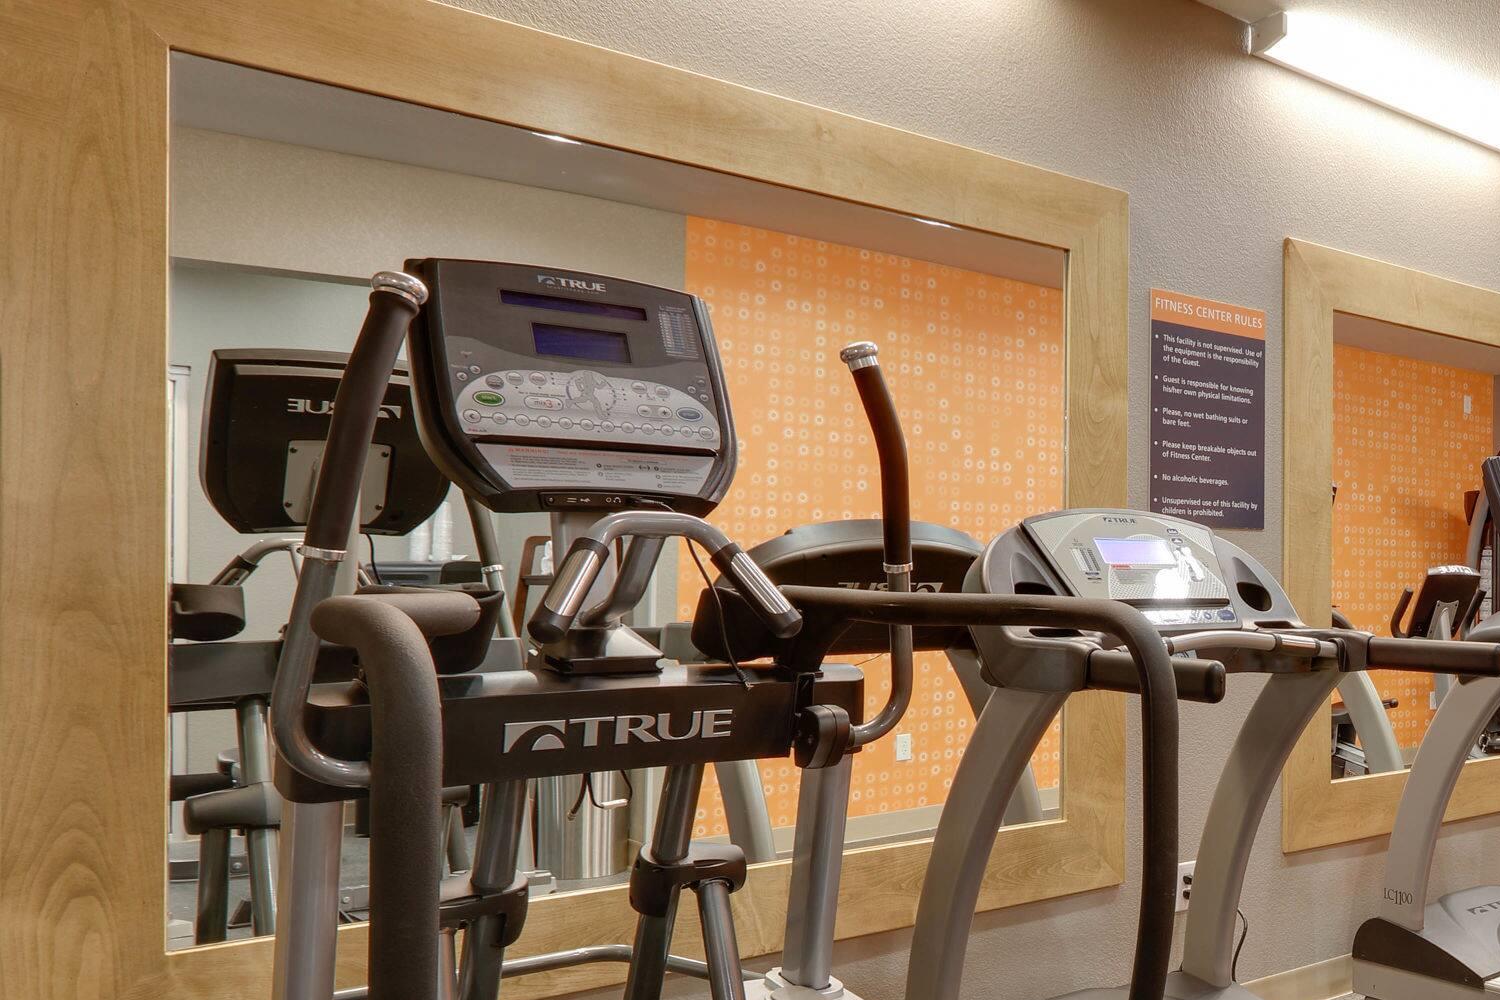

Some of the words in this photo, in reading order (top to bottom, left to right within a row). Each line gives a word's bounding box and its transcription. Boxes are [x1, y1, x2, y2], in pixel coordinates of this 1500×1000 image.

[556, 277, 607, 293] TRUE
[1156, 298, 1193, 315] FITNESS
[1196, 306, 1232, 322] CENTER
[1235, 314, 1262, 328] RULES
[1163, 334, 1175, 342] This
[1177, 336, 1196, 347] facility
[1203, 342, 1213, 350] not
[1214, 344, 1244, 354] supervised.
[1245, 349, 1254, 357] Use
[1163, 345, 1174, 353] the
[1175, 346, 1206, 359] equipment
[1207, 351, 1212, 359] is
[1213, 353, 1222, 361] the
[1223, 356, 1259, 368] responsibility
[1171, 356, 1181, 364] the
[1182, 358, 1200, 366] Guest.
[1163, 375, 1180, 384] Guest
[1181, 377, 1186, 385] is
[1187, 379, 1218, 390] responsible
[1220, 383, 1229, 391] for
[1230, 385, 1253, 396] knowing
[1163, 385, 1182, 394] his/her
[1198, 390, 1220, 399] physical
[1221, 393, 1252, 404] limitations.
[1163, 407, 1182, 417] Please,
[1206, 412, 1227, 424] bathing
[1163, 417, 1176, 425] bare
[1177, 419, 1191, 427] feet.
[1162, 440, 1181, 449] Please
[1182, 442, 1196, 451] keep
[1198, 443, 1225, 454] breakable
[1227, 447, 1246, 456] objects
[1170, 451, 1190, 460] Fitness
[1172, 474, 1198, 483] alcoholic
[1199, 477, 1229, 486] beverages.
[1162, 497, 1201, 506] Unsupervised
[1213, 499, 1219, 507] of
[1232, 501, 1249, 510] facility
[1251, 502, 1258, 511] by
[1193, 508, 1224, 517] prohibited.
[569, 709, 733, 747] TRUE
[1384, 887, 1413, 905] LC1100
